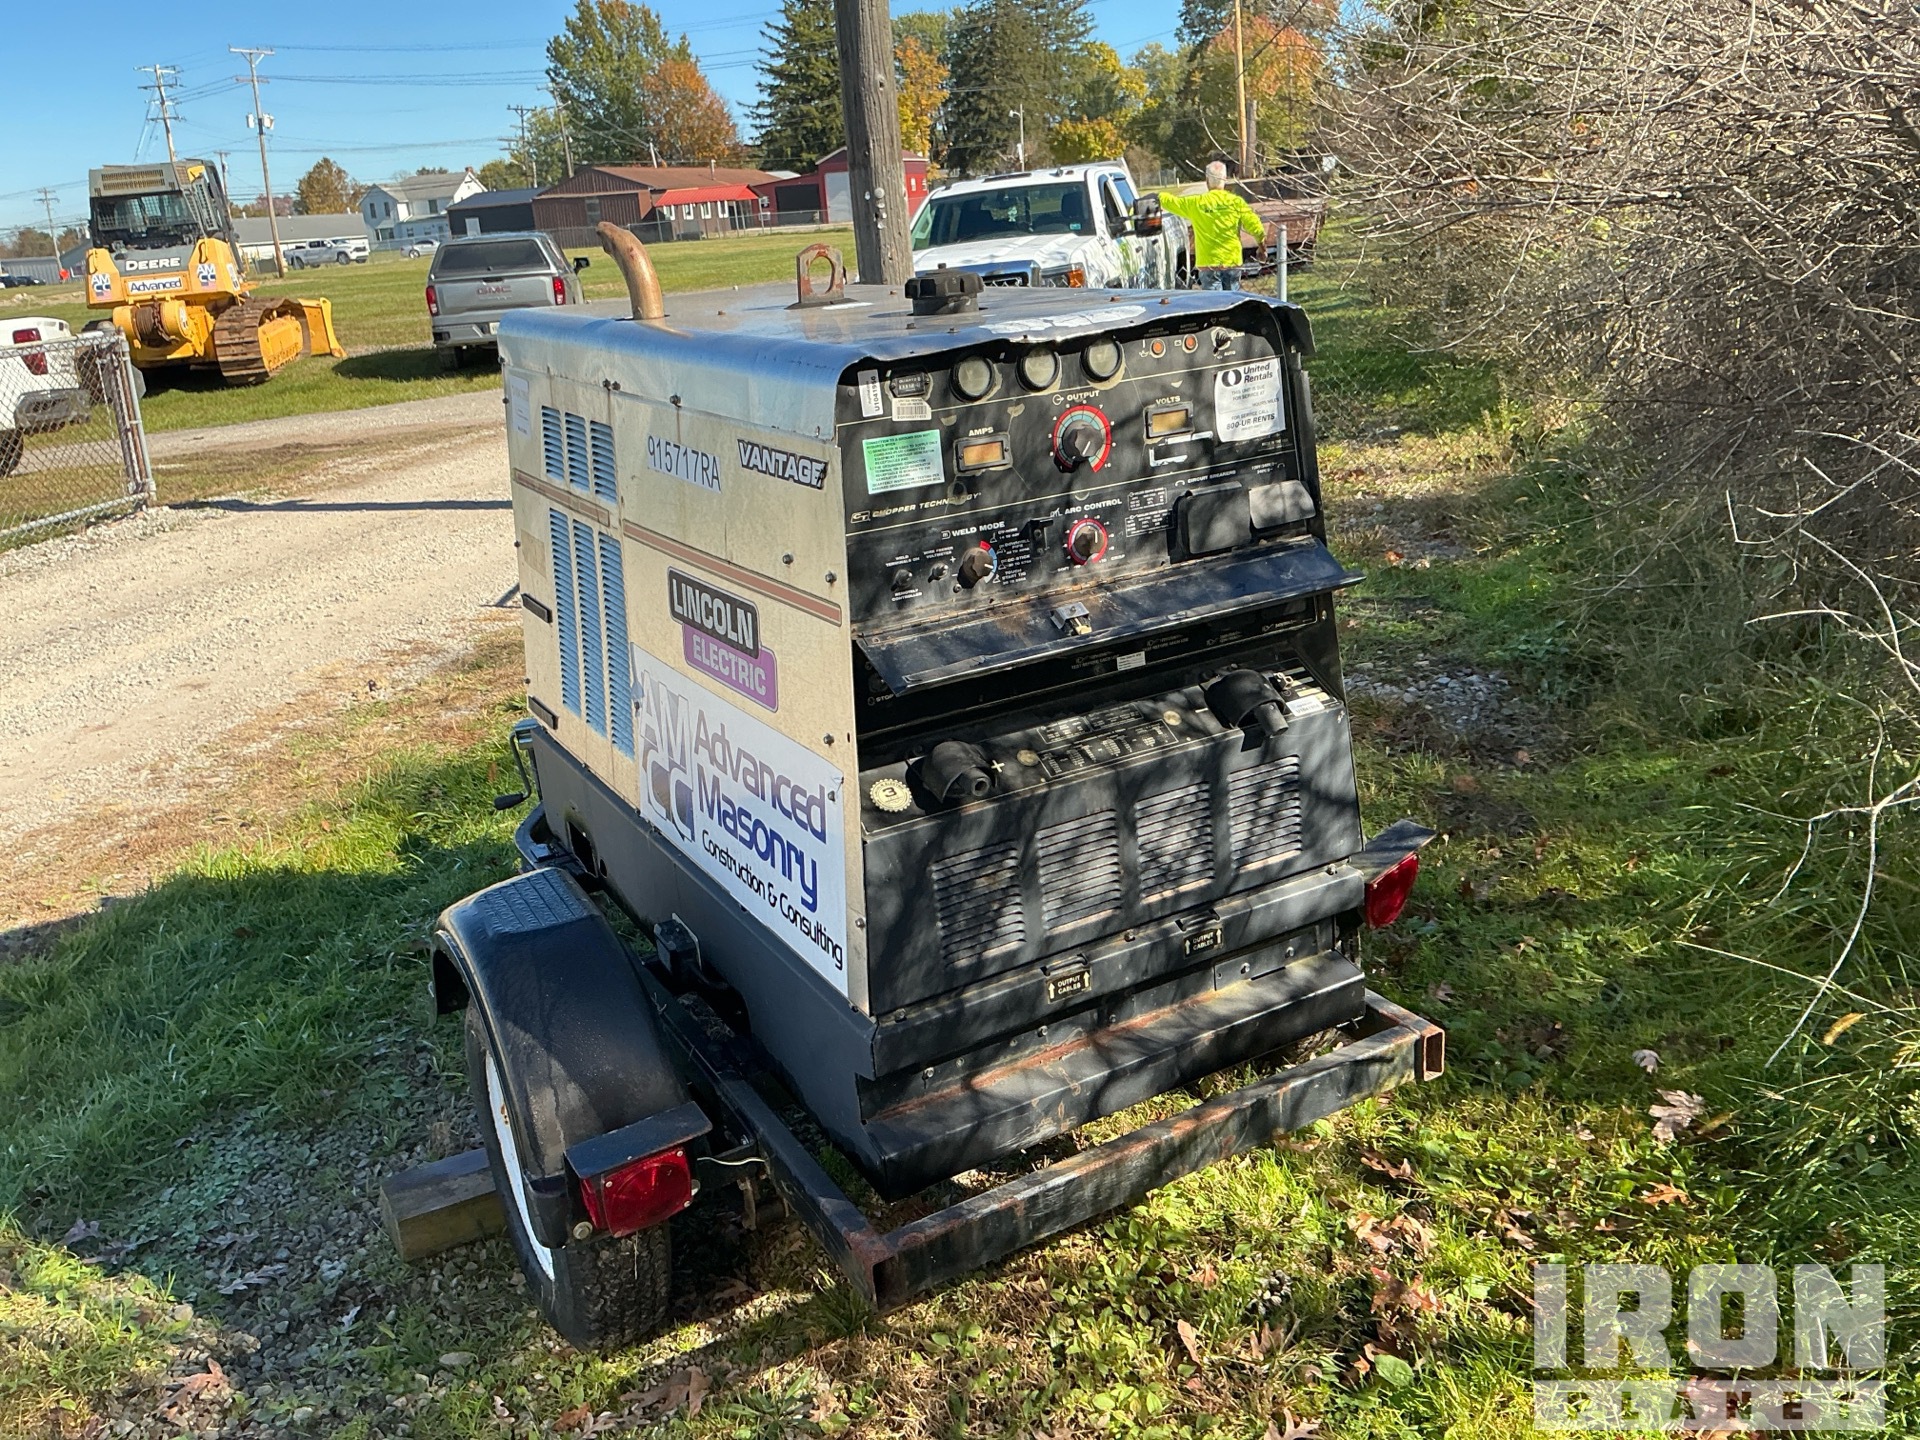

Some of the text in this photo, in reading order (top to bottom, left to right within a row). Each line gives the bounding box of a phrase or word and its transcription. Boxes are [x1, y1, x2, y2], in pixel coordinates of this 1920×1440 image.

[125, 257, 180, 271] DEERE
[130, 278, 181, 292] Advanced
[477, 286, 512, 295] GMC
[1242, 362, 1271, 374] United
[1243, 370, 1273, 383] Rentals
[1066, 390, 1099, 400] OUTPUT
[1156, 396, 1181, 406] VOLTS
[969, 426, 994, 437] AMPS
[648, 435, 721, 492] 915717RA
[738, 441, 826, 488] VANTAGE
[873, 505, 916, 518] CHOPPER
[1064, 505, 1082, 514] ARC
[1083, 498, 1122, 510] CONTROL
[951, 520, 1005, 537] WELD MODE
[672, 578, 755, 651] LINCOLN
[693, 634, 767, 696] ELECTRIC
[875, 692, 894, 702] STOP
[694, 709, 827, 845] Advanced
[881, 785, 898, 798] 3
[696, 763, 817, 913] Masonry
[702, 828, 843, 971] Construction & Consulting
[1191, 931, 1214, 944] OUTPUT
[1191, 938, 1215, 950] CABLES
[1056, 974, 1081, 987] OUTPUT
[1056, 981, 1082, 995] CABLES
